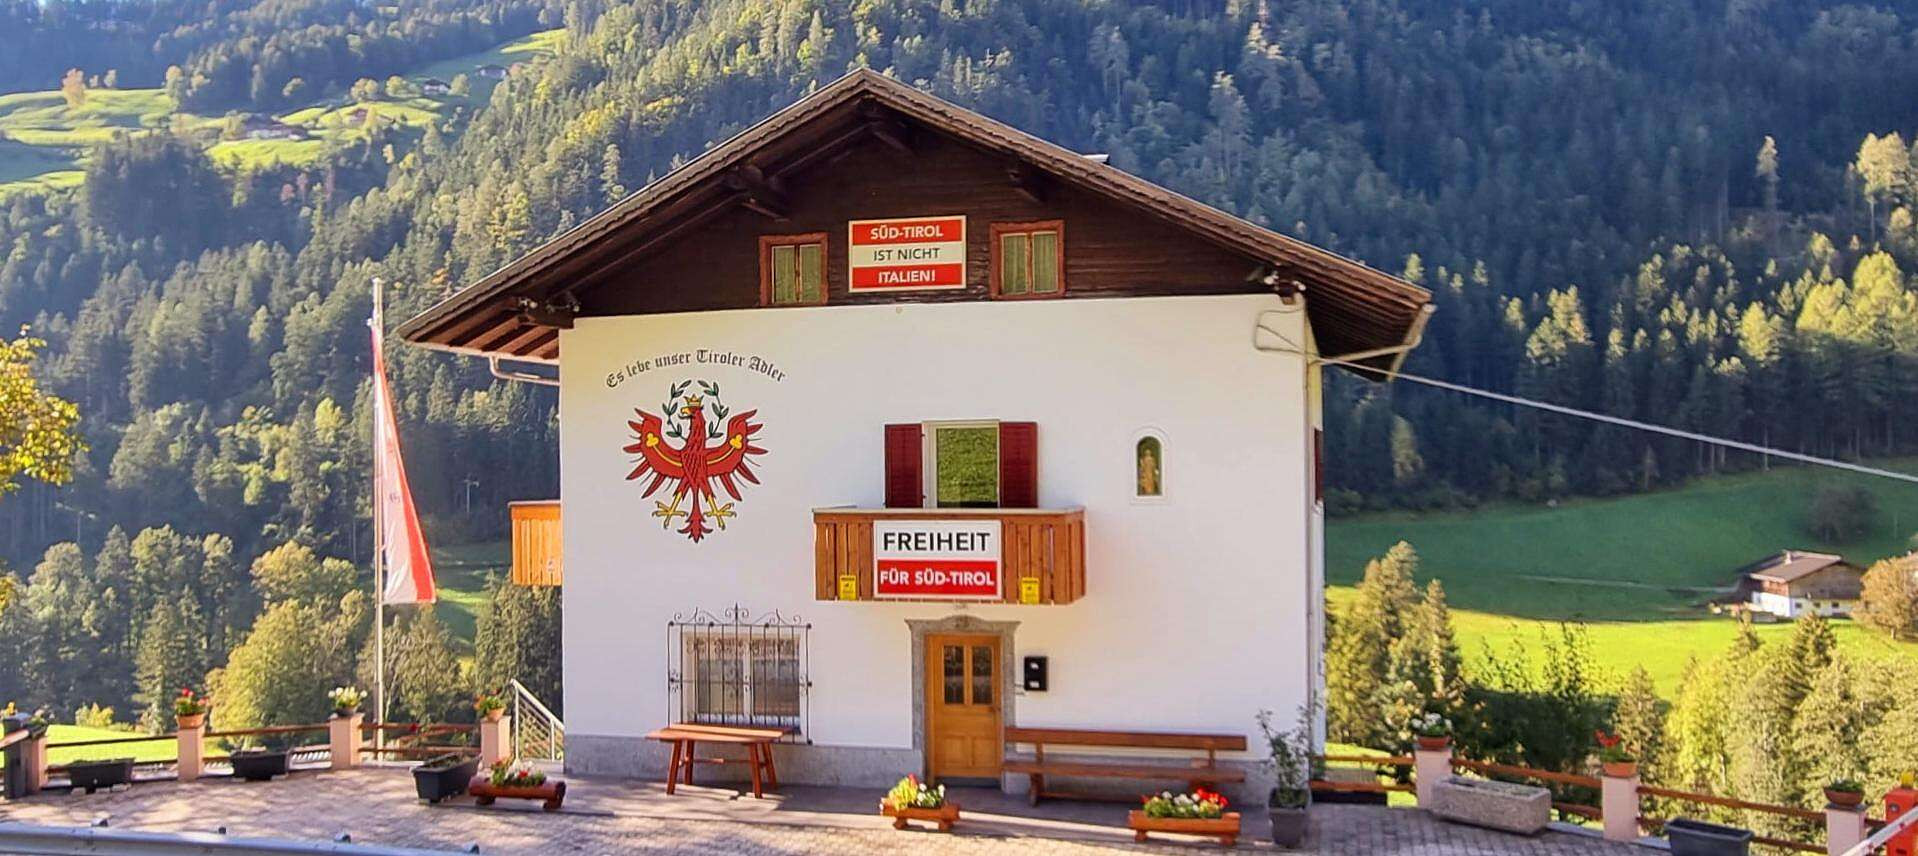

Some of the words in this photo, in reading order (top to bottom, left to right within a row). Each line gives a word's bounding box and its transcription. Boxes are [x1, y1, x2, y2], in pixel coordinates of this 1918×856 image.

[870, 225, 944, 240] SÜD-TIROL
[874, 250, 893, 261] IST
[897, 248, 940, 260] NICHT
[878, 270, 936, 283] ITALIEN!
[606, 369, 625, 388] Es
[626, 360, 651, 377] lebe
[655, 353, 692, 368] unser
[696, 350, 746, 367] Tiroler
[749, 356, 786, 382] Adler
[883, 532, 991, 551] FREIHEIT
[880, 567, 909, 585] FÜR
[914, 568, 995, 586] SÜD-TIROL
